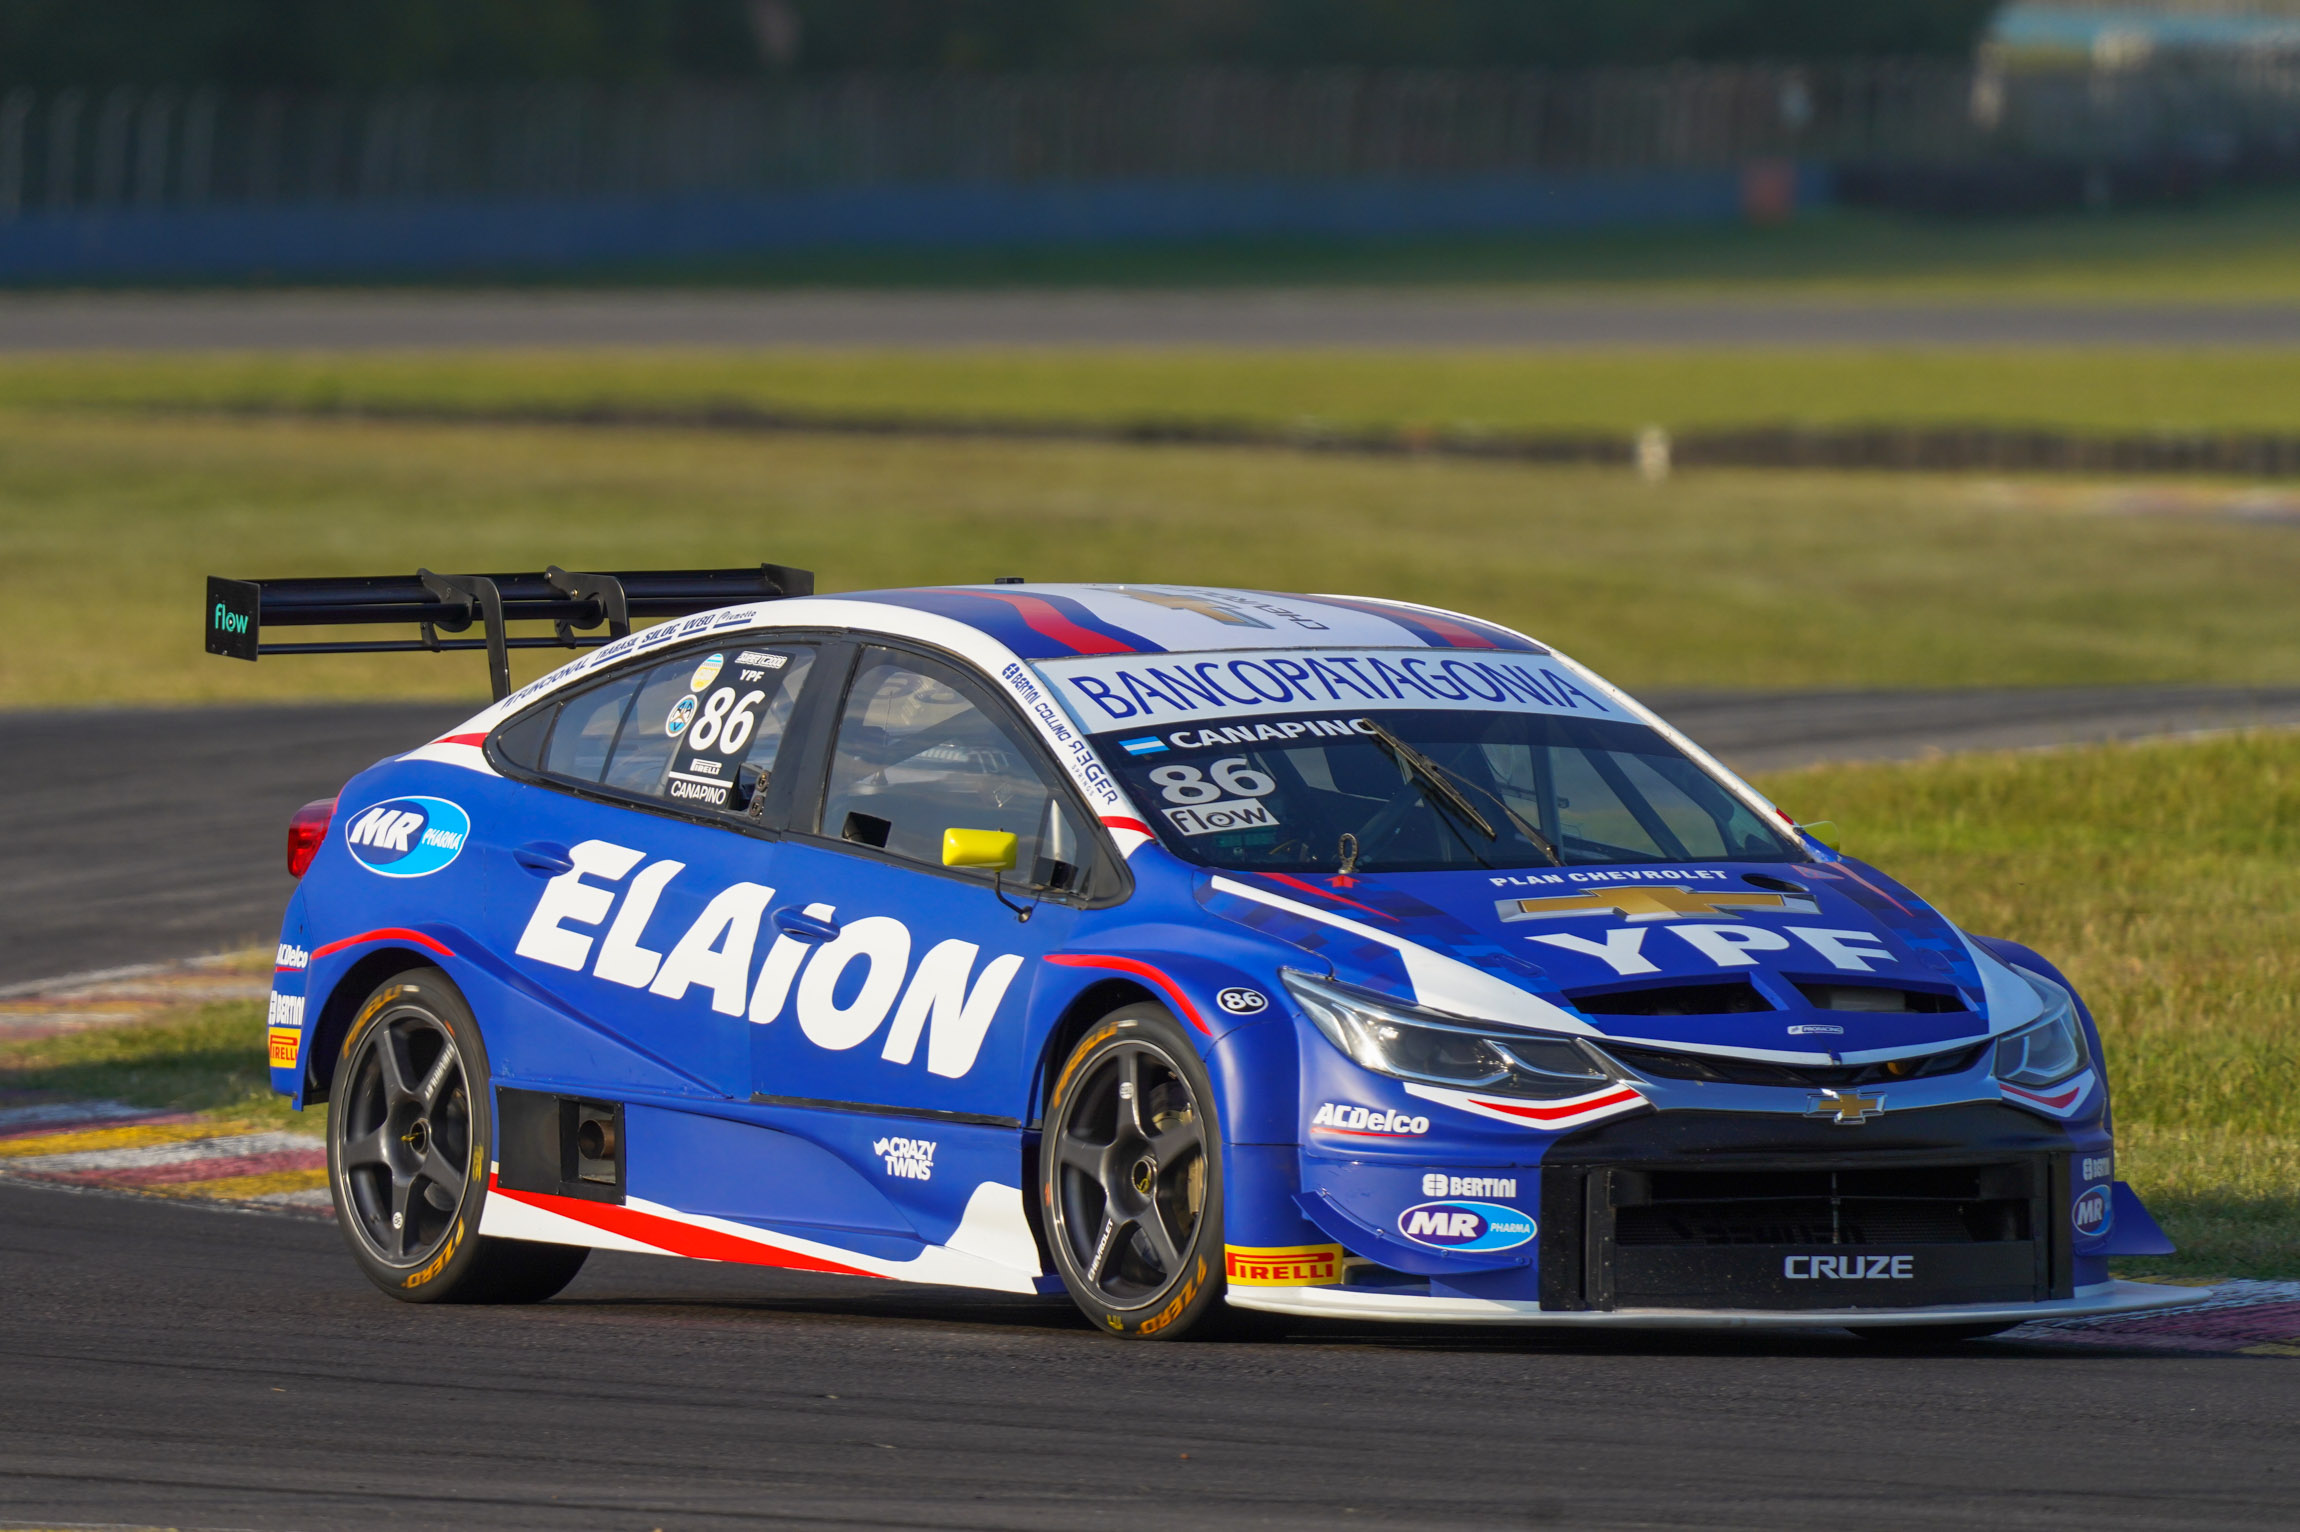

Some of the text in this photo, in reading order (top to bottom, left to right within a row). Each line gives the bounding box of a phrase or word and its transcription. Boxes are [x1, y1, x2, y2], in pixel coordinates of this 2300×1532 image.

[215, 603, 249, 634] flow
[740, 669, 765, 683] YPF
[1010, 671, 1041, 705] BERTINI
[1068, 656, 1610, 713] BANCOPATAGONIA
[689, 686, 766, 755] 86
[1034, 702, 1073, 743] COLLINO
[1169, 718, 1380, 748] CANAPINO
[690, 758, 723, 775] PIRELLI
[1071, 763, 1096, 798] SPRINGS
[670, 780, 727, 805] CANAPINO
[1149, 758, 1277, 805] 86
[349, 807, 463, 852] MR PHARMA
[1170, 807, 1269, 833] flow
[1489, 870, 1729, 887] PLAN CHEVROLET
[1524, 924, 1899, 976] YPF
[275, 993, 306, 1026] BERTINI
[1221, 988, 1265, 1010] 86
[270, 1033, 298, 1061] PIRELLI
[1313, 1102, 1430, 1135] ACDelco
[889, 1136, 937, 1161] CRAZY
[885, 1155, 934, 1181] TWINS
[1450, 1176, 1517, 1198] BERTINI
[1406, 1210, 1531, 1238] MR PHARMA
[2076, 1198, 2103, 1226] MR
[1087, 1218, 1115, 1282] CHEVROLET
[1226, 1251, 1335, 1280] PIRELLI
[1784, 1255, 1915, 1279] CRUZE
